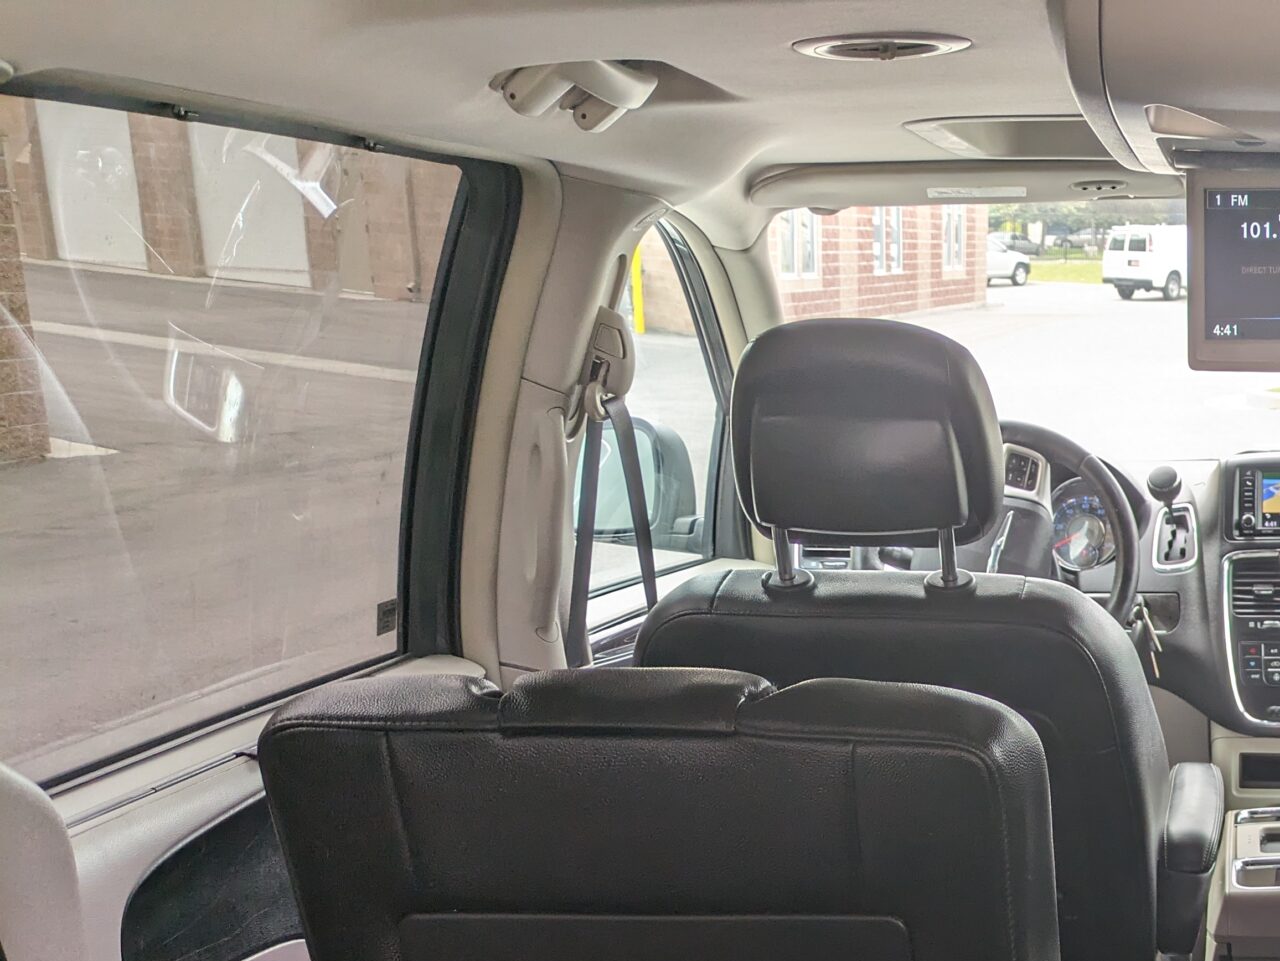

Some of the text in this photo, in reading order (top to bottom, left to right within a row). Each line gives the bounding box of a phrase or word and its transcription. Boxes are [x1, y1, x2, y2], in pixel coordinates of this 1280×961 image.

[1215, 194, 1249, 206] 1 FM
[1213, 324, 1238, 336] 4:41
